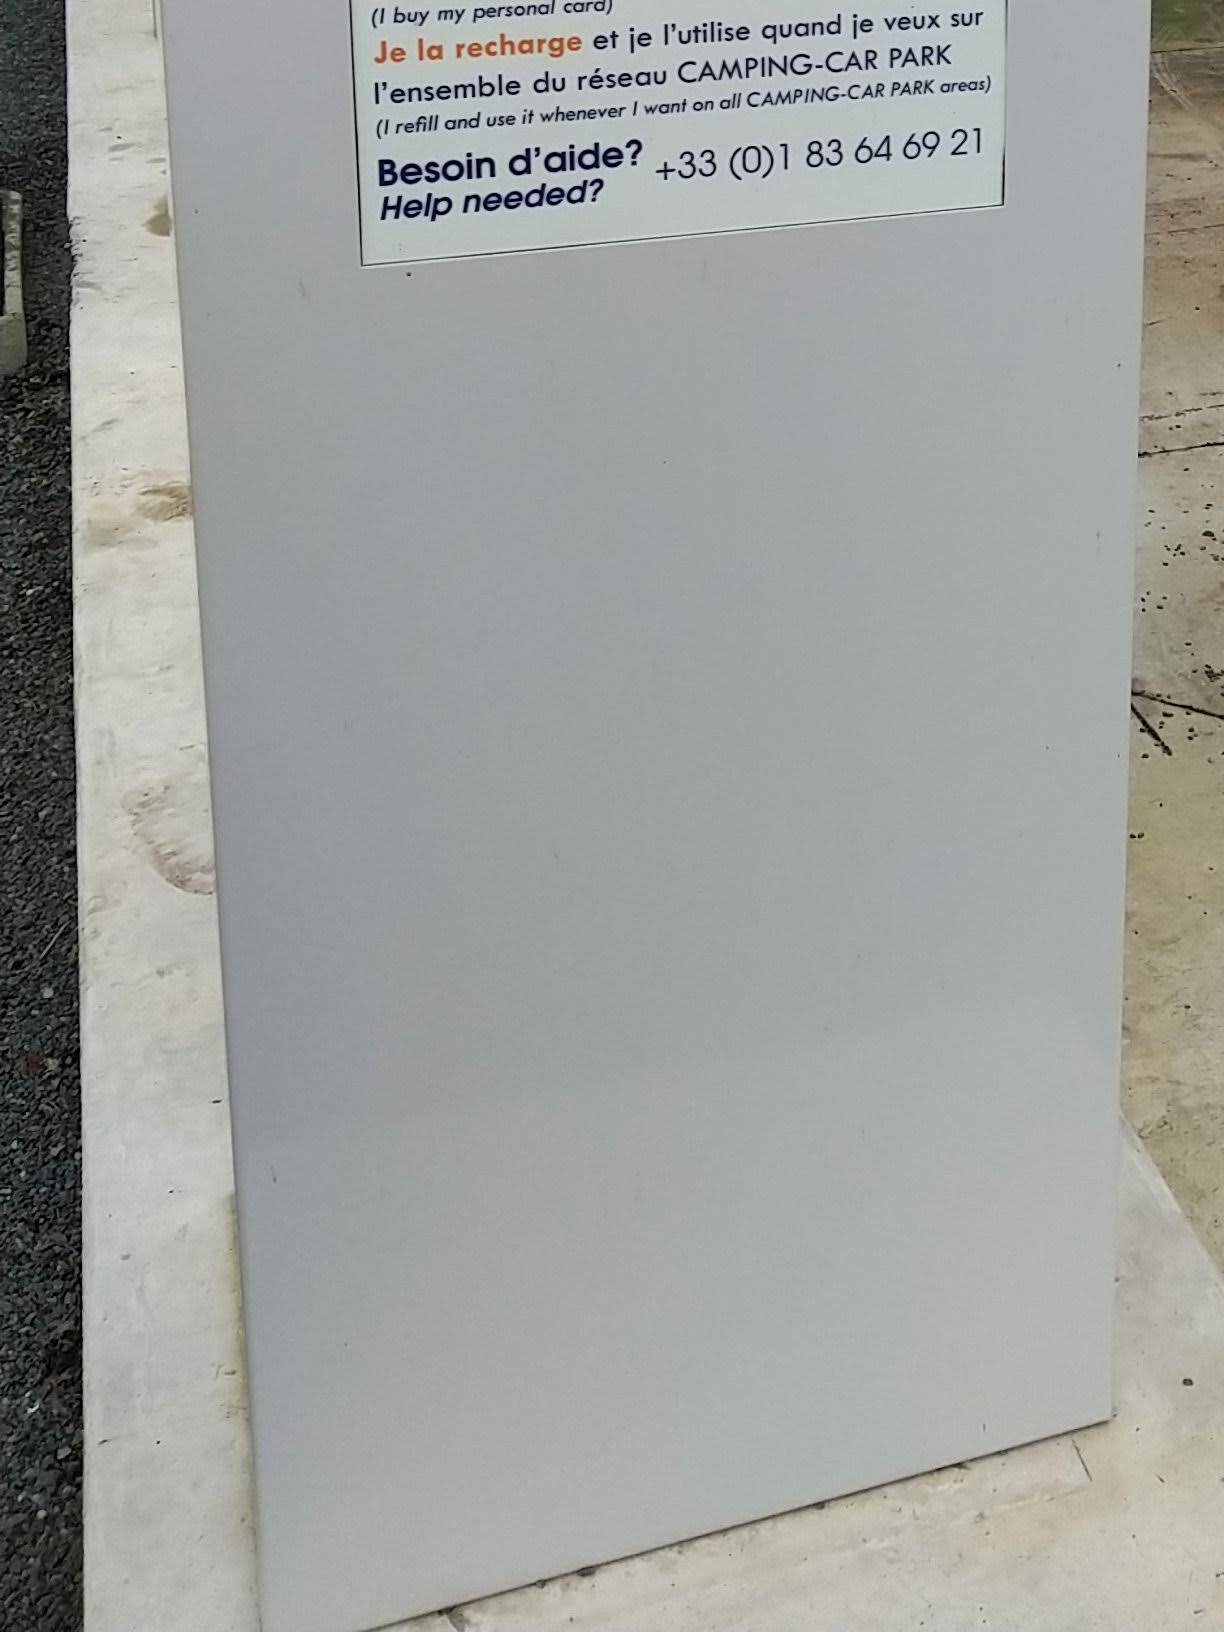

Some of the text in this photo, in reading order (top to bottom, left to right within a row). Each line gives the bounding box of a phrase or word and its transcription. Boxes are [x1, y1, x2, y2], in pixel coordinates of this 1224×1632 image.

[371, 8, 385, 28] (I
[393, 6, 430, 26] buy
[437, 8, 465, 25] my
[374, 11, 984, 64] Je la recharge et je l'utilise quand je veux sur
[374, 44, 952, 105] l'ensemble du réseau CAMPING-CAR PARK
[376, 75, 992, 139] (I refill and use it whenever I want on all CAMPING-CAR PARK areas)
[378, 139, 643, 187] Besoin d'aide?
[655, 128, 982, 181] +33 (0)1 83 64 69 21
[380, 178, 605, 222] Help needed?
